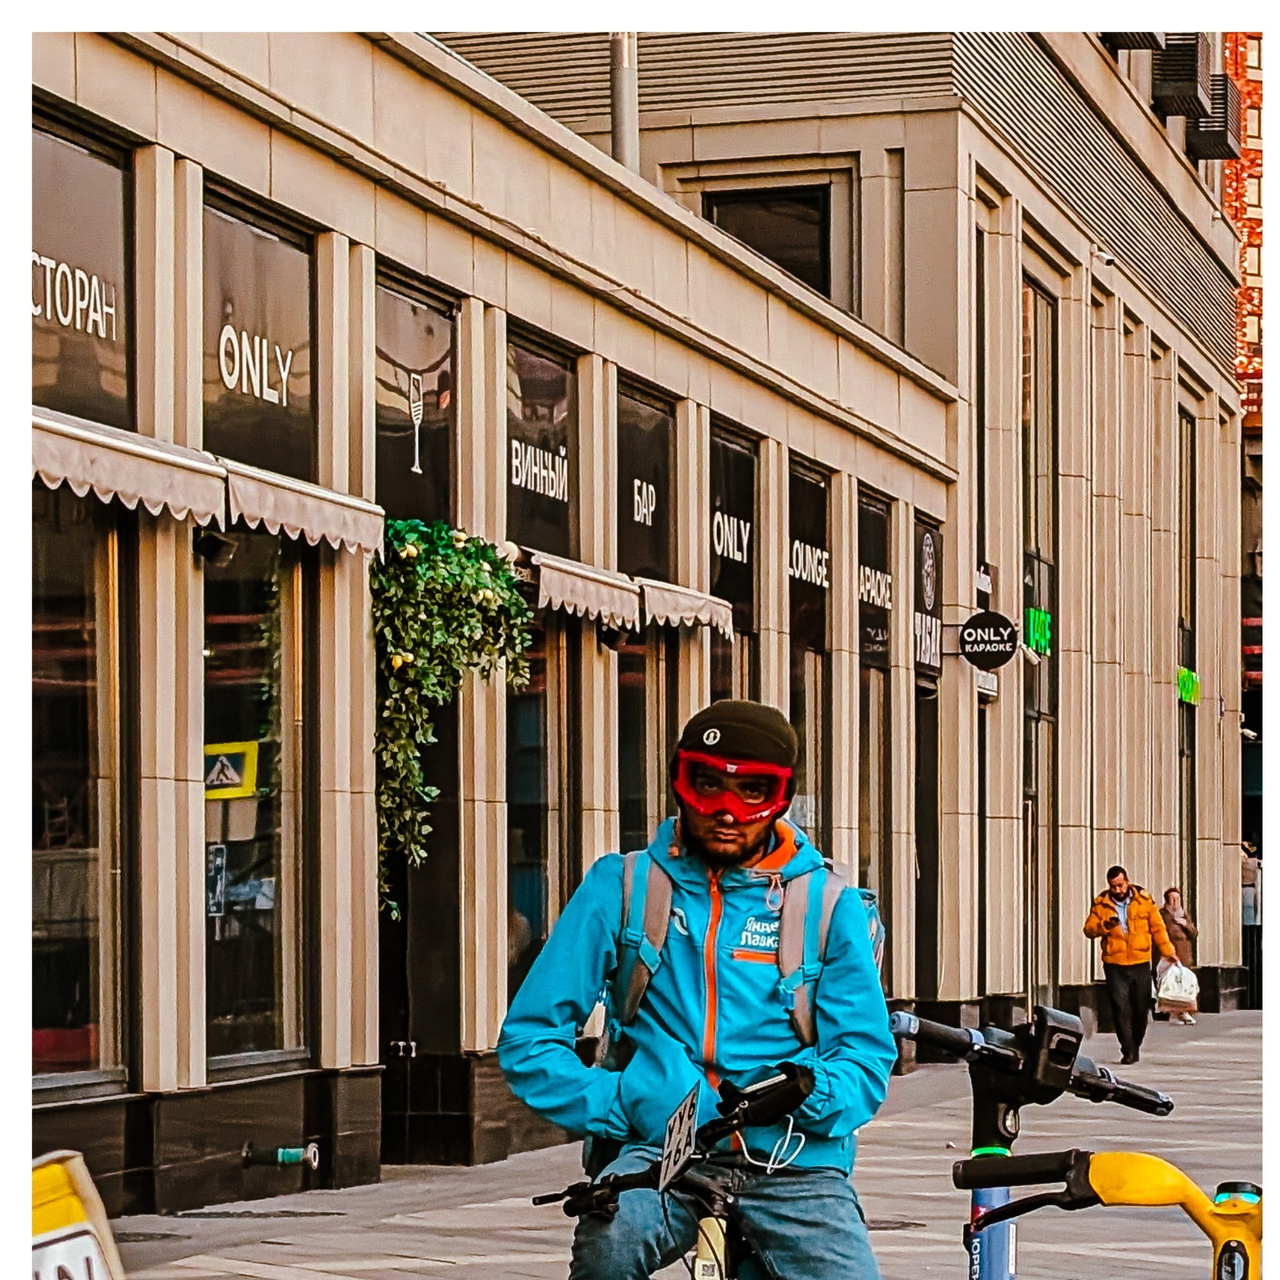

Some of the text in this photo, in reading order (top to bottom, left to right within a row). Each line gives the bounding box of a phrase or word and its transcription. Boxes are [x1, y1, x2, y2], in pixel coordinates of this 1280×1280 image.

[219, 324, 293, 407] ONLY
[511, 439, 569, 503] ВИННЫЙ
[633, 478, 656, 526] БАР
[713, 511, 751, 564] ONLY
[859, 564, 893, 610] АРАОКЕ
[963, 627, 1013, 642] ONLY
[965, 642, 1013, 653] КАРАОКЕ
[744, 917, 780, 934] Янде
